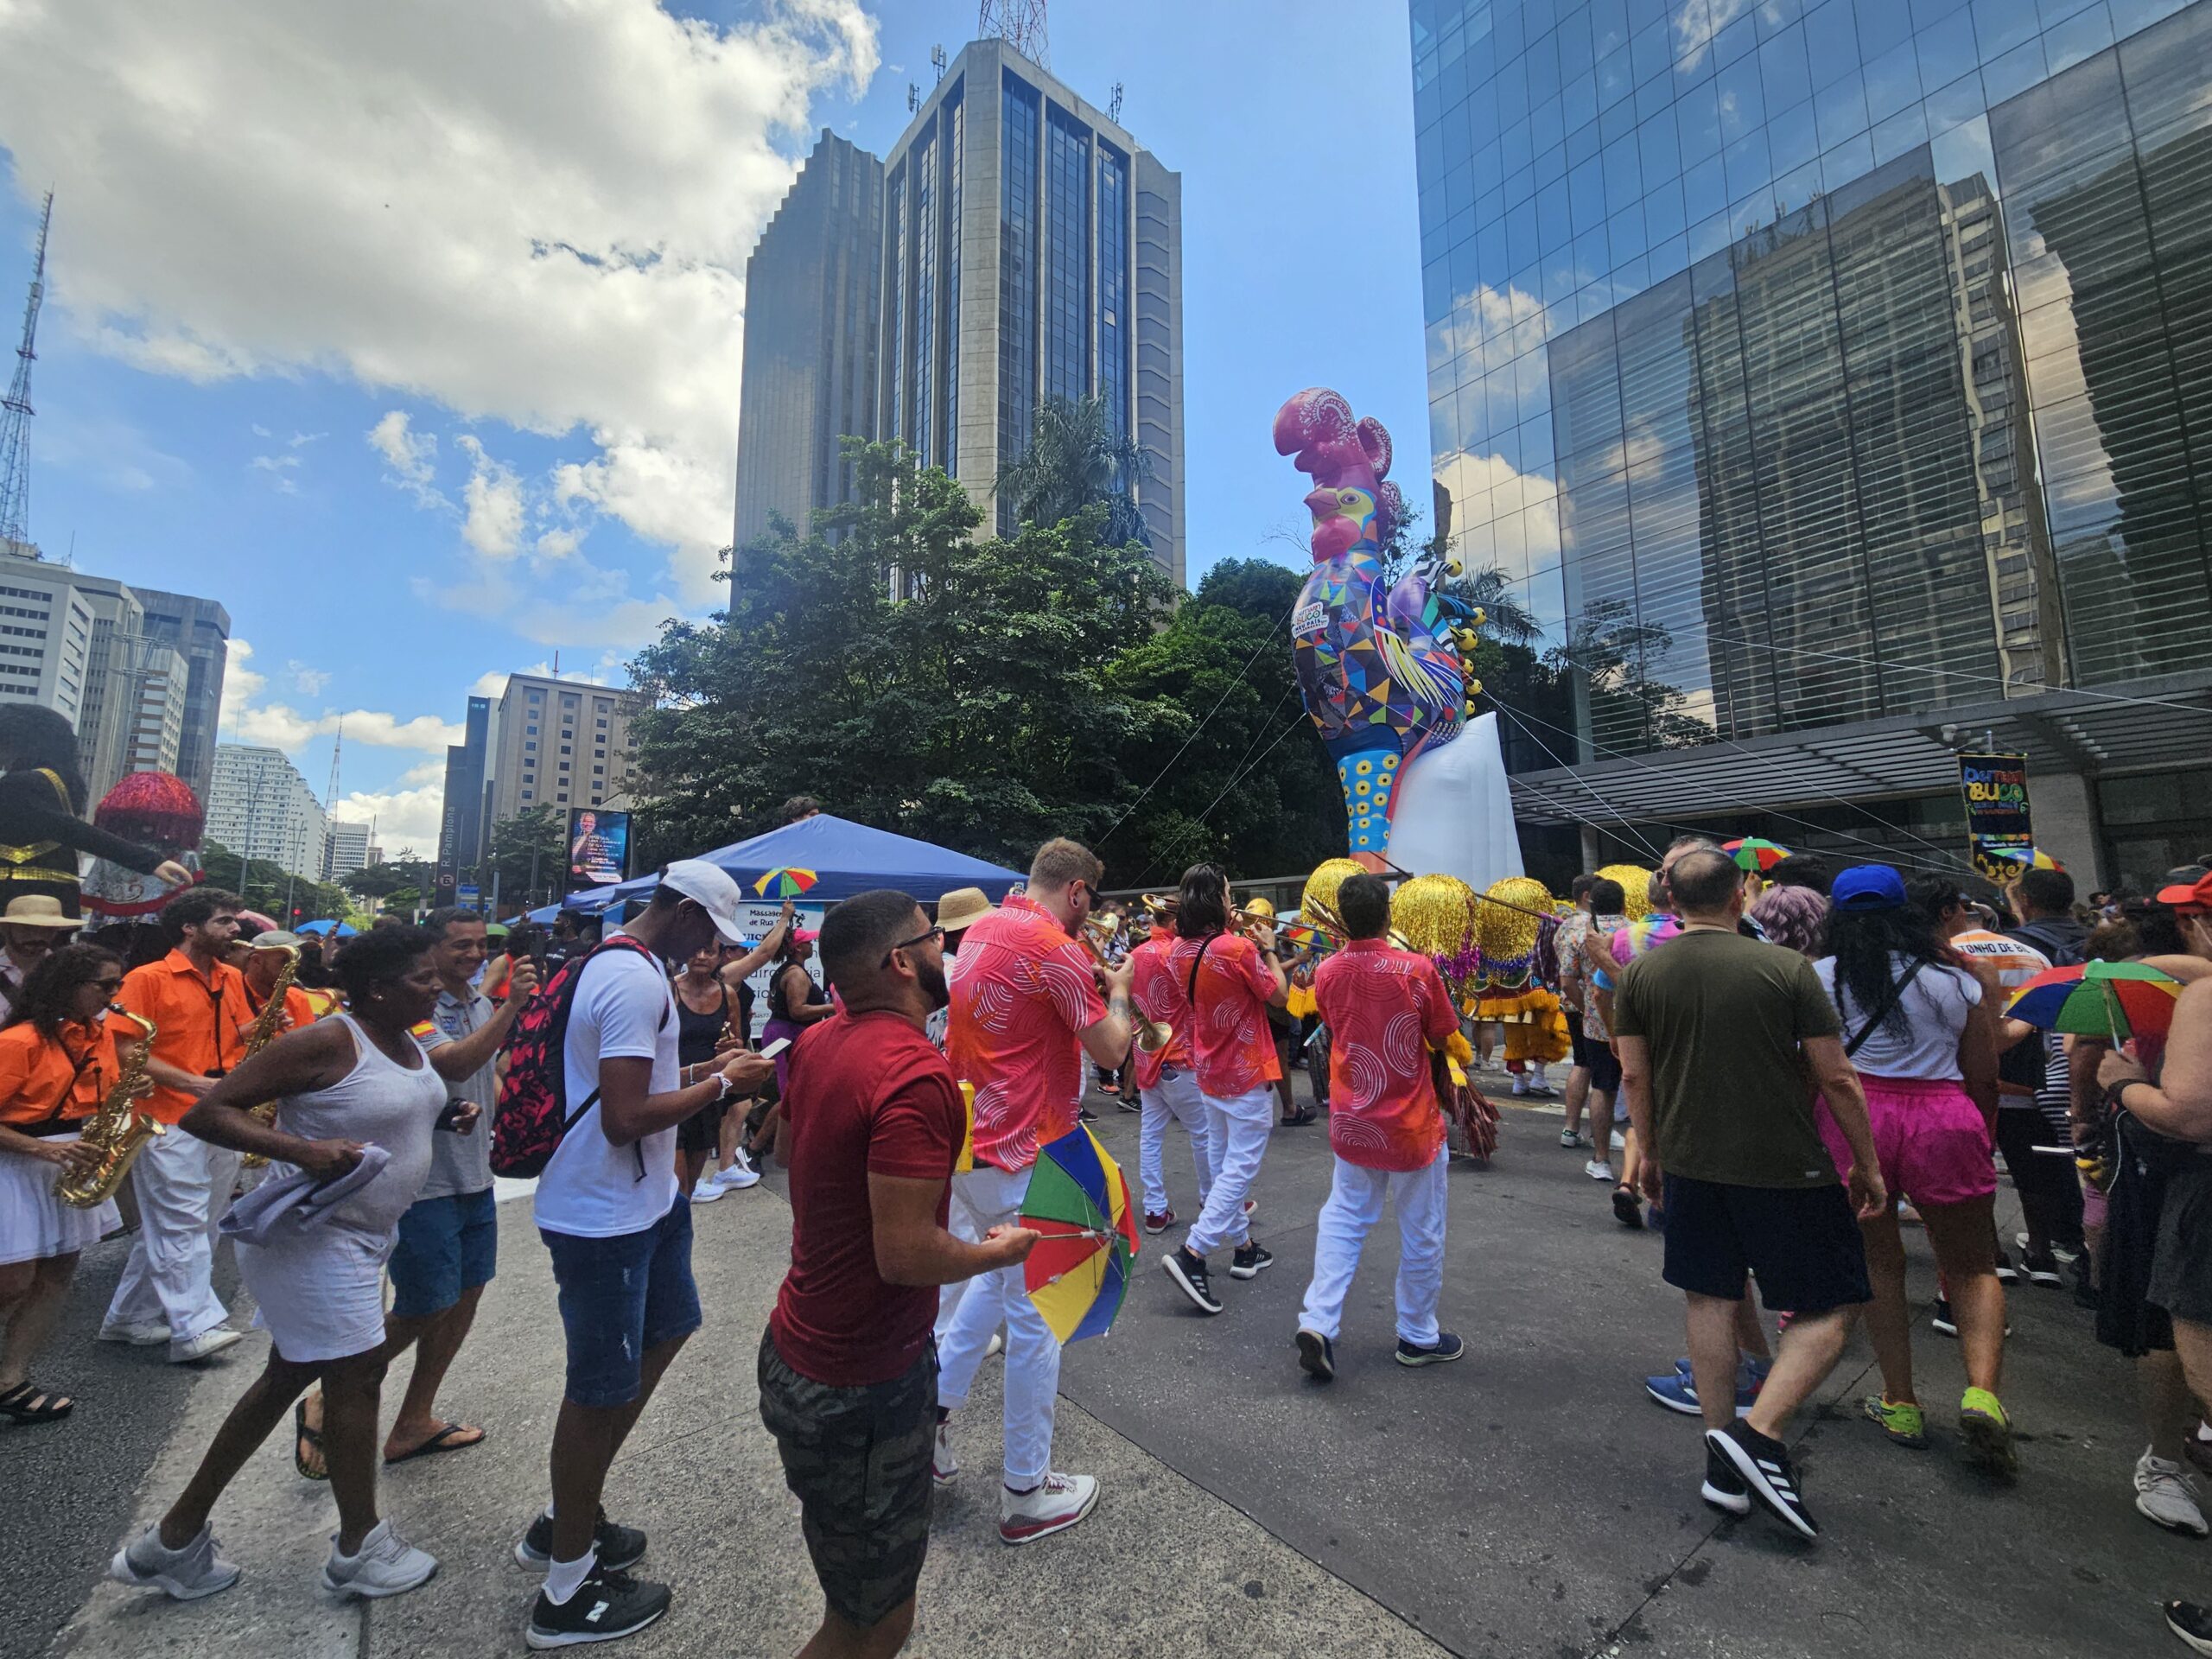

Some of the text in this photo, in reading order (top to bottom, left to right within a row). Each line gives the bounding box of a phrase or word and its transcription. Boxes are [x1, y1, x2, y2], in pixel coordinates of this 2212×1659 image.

[441, 806, 455, 868] R. Pamplona
[1998, 943, 2014, 952] DE
